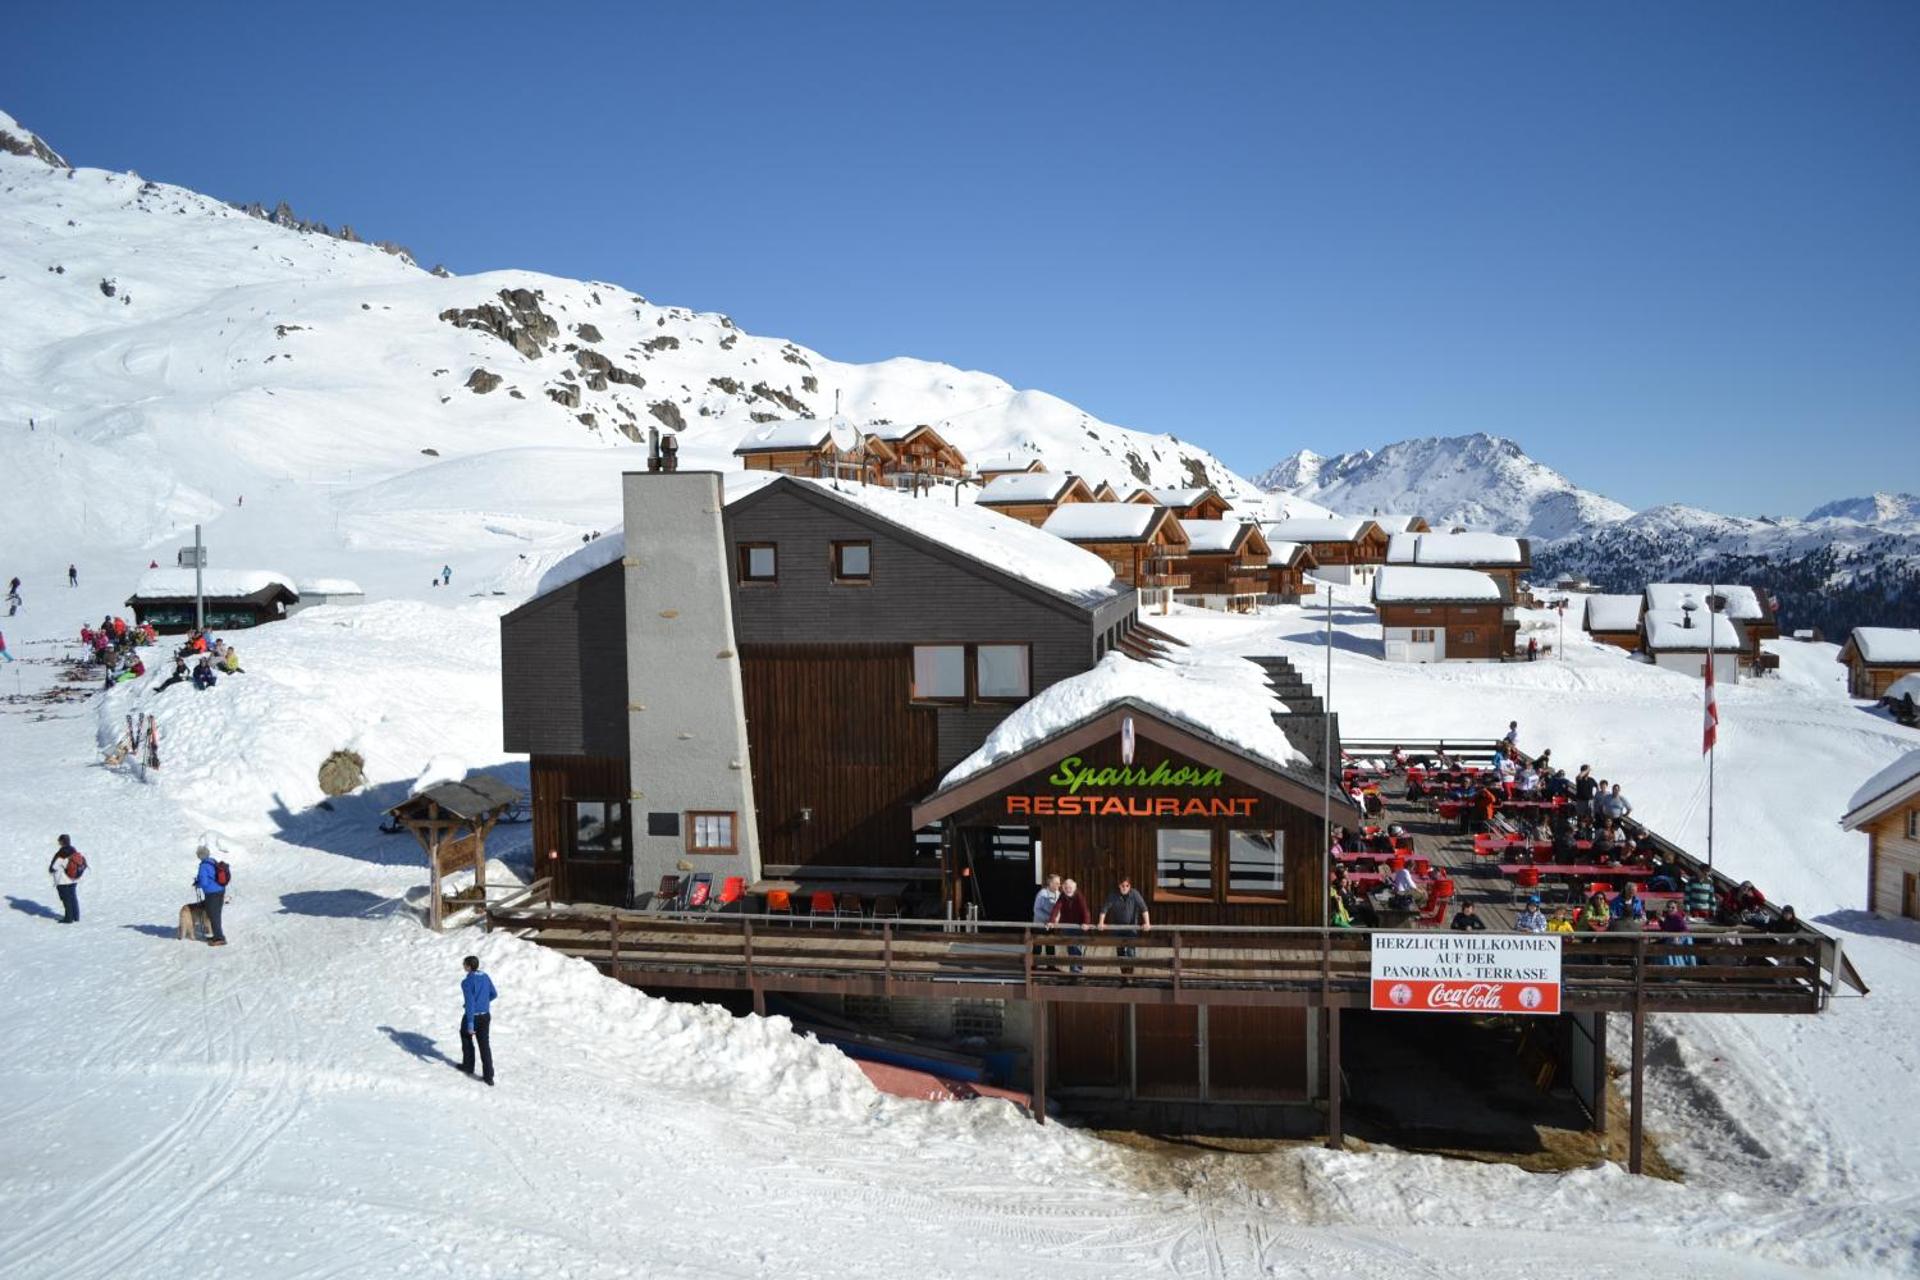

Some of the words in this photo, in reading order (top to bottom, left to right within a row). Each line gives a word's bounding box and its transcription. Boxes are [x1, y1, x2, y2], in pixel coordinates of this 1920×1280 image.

[1050, 756, 1224, 794] Sparrhorn
[1007, 795, 1259, 817] RESTAURANT
[1376, 937, 1449, 950] HERZLICH
[1453, 938, 1556, 951] WILLKOMMEN
[1435, 953, 1463, 964] AUF
[1467, 953, 1495, 965] DER
[1383, 966, 1462, 978] PANORAMA
[1474, 967, 1548, 980] TERRASSE
[1427, 983, 1503, 1009] Coca-Cola
